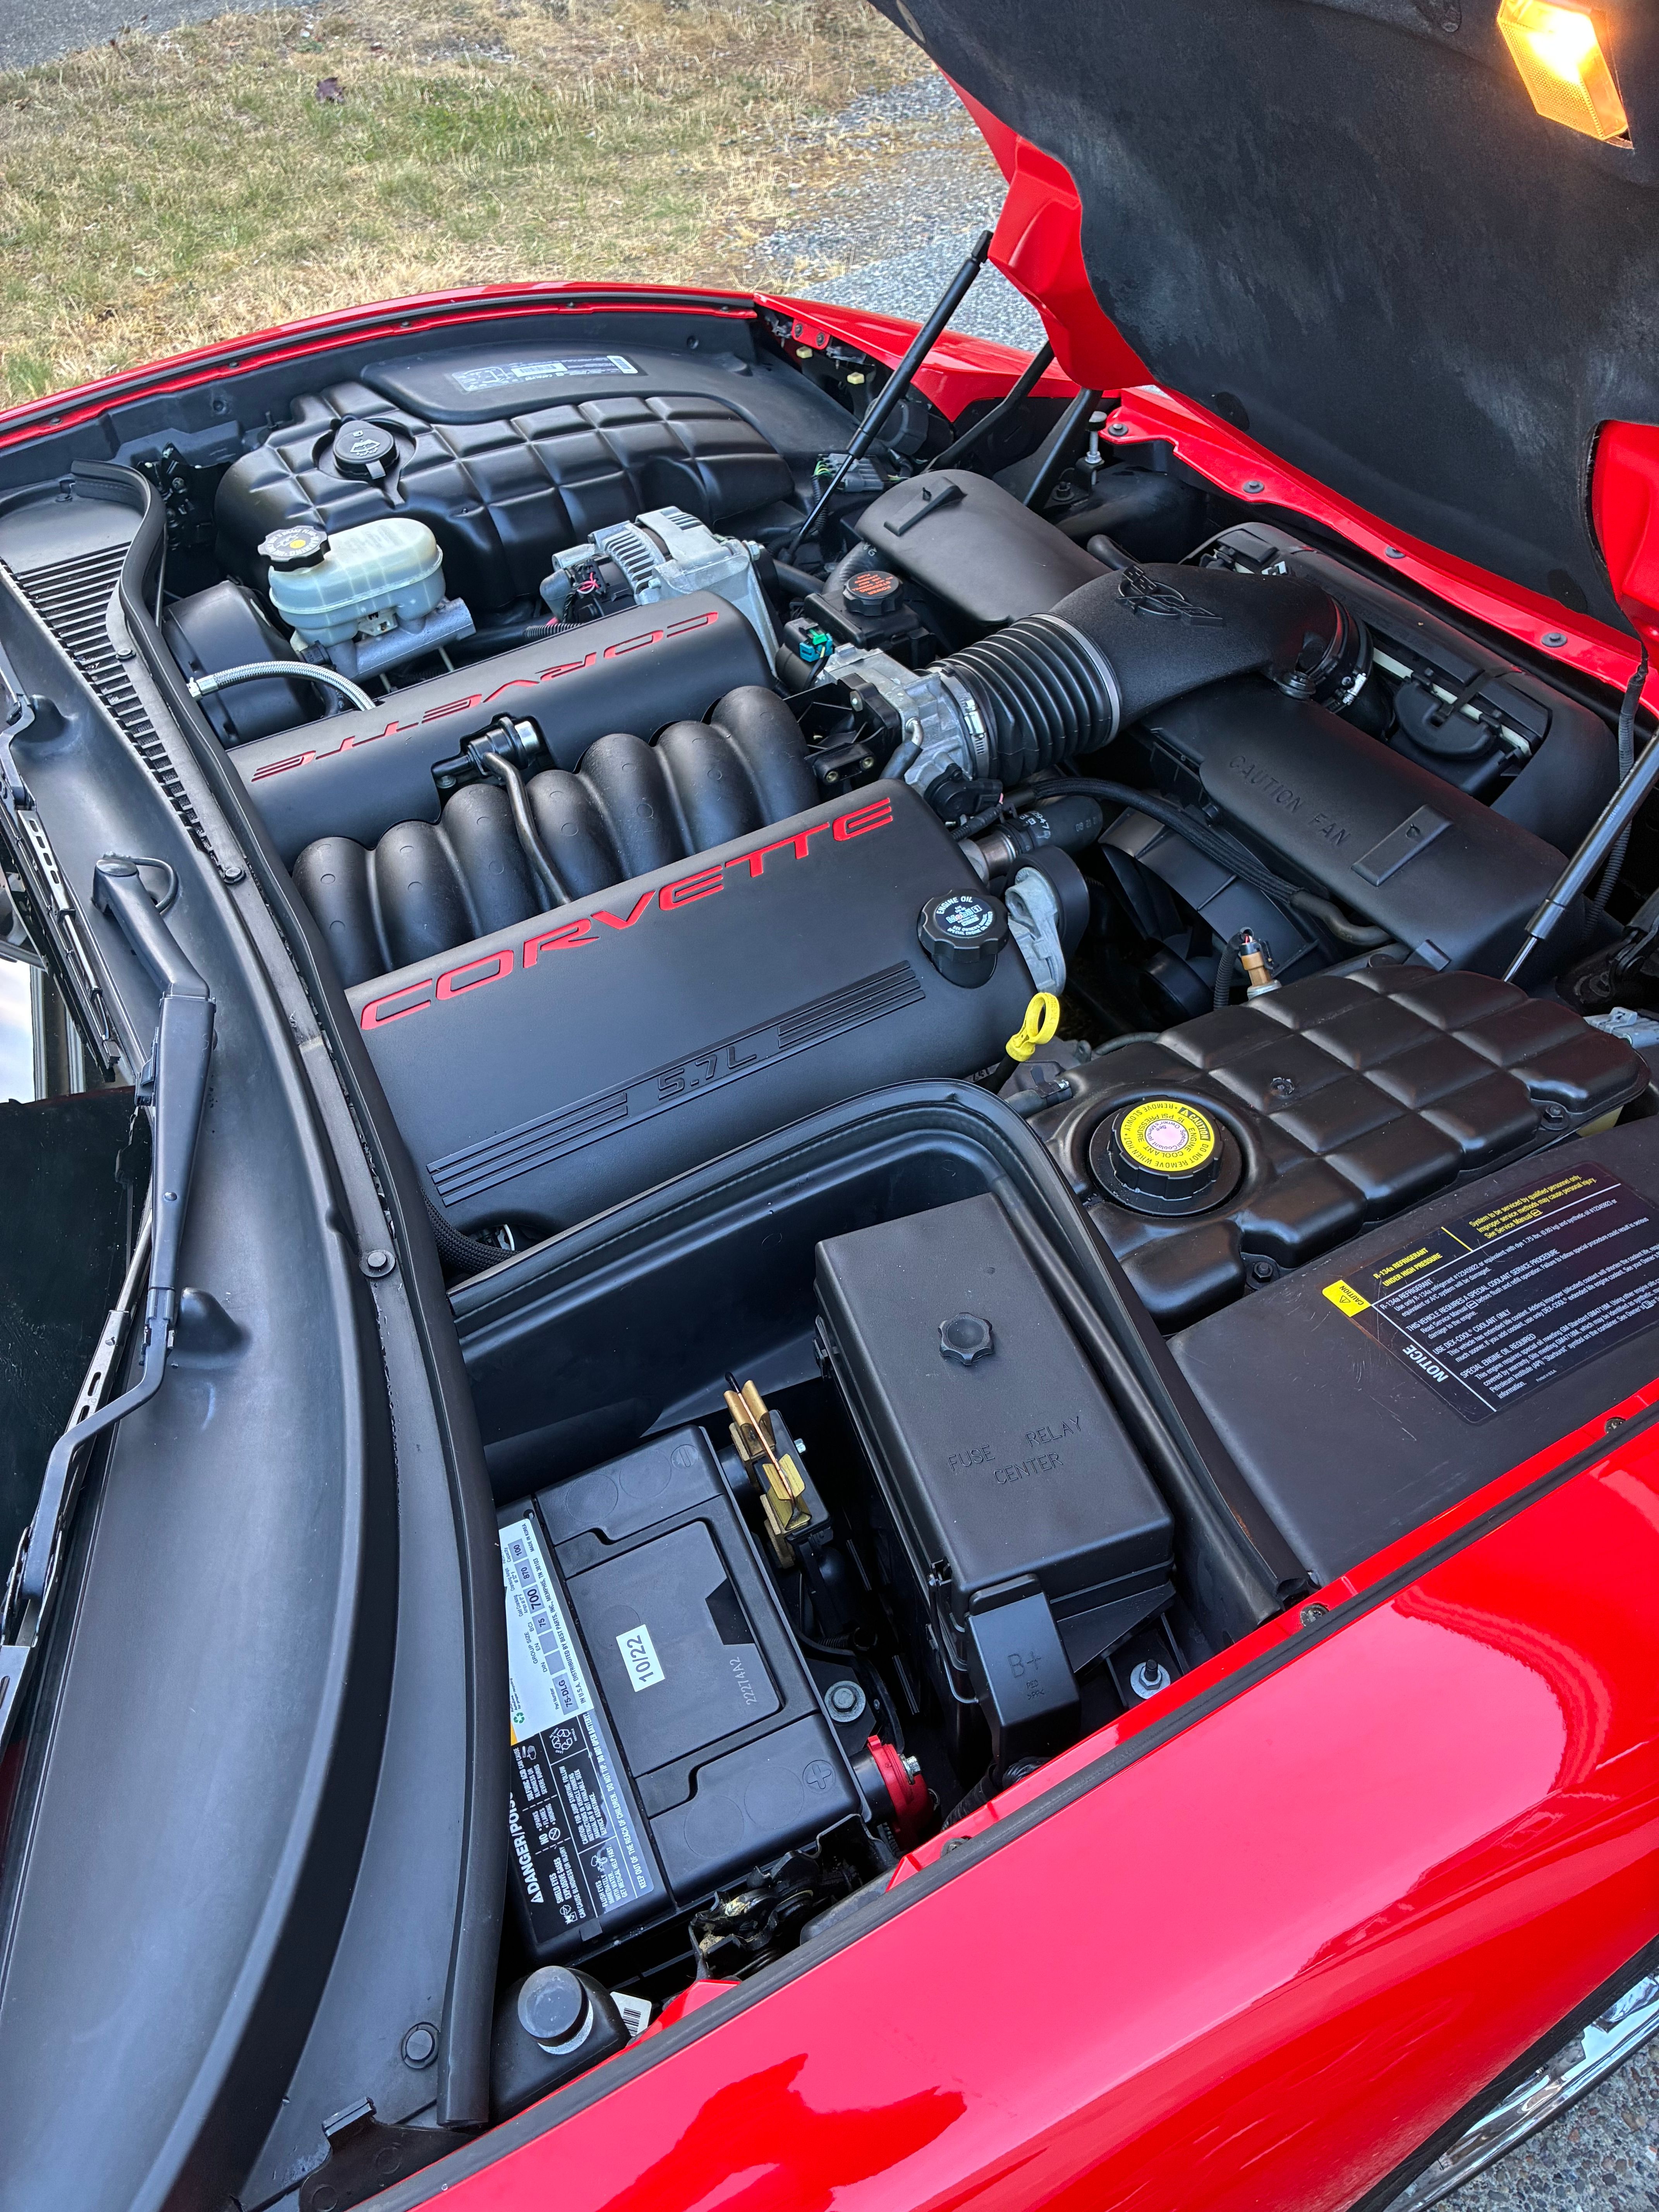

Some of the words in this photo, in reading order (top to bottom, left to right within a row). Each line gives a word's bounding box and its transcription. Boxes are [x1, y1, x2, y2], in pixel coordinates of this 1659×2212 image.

[251, 611, 718, 782] CORVETTE
[1229, 756, 1305, 813] CAUTION
[1309, 812, 1351, 846] FAN
[361, 797, 893, 1030] CORVETTE
[936, 897, 959, 914] ENGINE
[946, 908, 974, 924] Mobil
[658, 1046, 757, 1100] 5.7L
[1144, 1103, 1173, 1112] REMOVE
[1125, 1110, 1142, 1131] SLOWLY
[1137, 1114, 1159, 1142] PRESSURE
[1189, 1114, 1209, 1139] CAUTION
[1147, 1124, 1156, 1141] Manual
[1177, 1129, 1186, 1147] Special
[1184, 1128, 1197, 1152] ENGINE
[1124, 1137, 1135, 1149] HOT
[1143, 1145, 1183, 1158] COOLANT
[1153, 1142, 1177, 1150] Coolant
[1200, 1144, 1209, 1152] DO
[1132, 1149, 1152, 1165] WHEN
[1190, 1152, 1203, 1164] NOT
[1484, 1230, 1497, 1238] See
[1494, 1222, 1515, 1233] Service
[1512, 1213, 1533, 1225] Manual
[1372, 1266, 1395, 1279] R-134a
[1391, 1247, 1429, 1269] REFRIGERANT
[1382, 1274, 1403, 1286] UNDER
[1400, 1266, 1417, 1277] HIGH
[1413, 1252, 1443, 1269] PRESSURE
[1339, 1285, 1364, 1306] CAUTION
[1379, 1297, 1401, 1310] R-134a
[1397, 1278, 1434, 1299] REFRIGERANT
[1405, 1322, 1421, 1332] THIS
[1417, 1310, 1441, 1325] VEHICLE
[1438, 1297, 1466, 1314] REQUIRES
[1466, 1285, 1491, 1298] SPECIAL
[1487, 1272, 1512, 1287] COOLANT
[1509, 1262, 1532, 1276] SERVICE
[1528, 1249, 1560, 1266] PROCEDURE
[1432, 1345, 1447, 1354] USE
[1471, 1316, 1499, 1333] COOLANT
[1495, 1308, 1512, 1319] ONLY
[1402, 1344, 1449, 1382] NOTICE
[1459, 1363, 1485, 1378] SPECIAL
[1480, 1352, 1503, 1366] ENGINE
[1499, 1347, 1513, 1355] OIL
[1508, 1333, 1537, 1350] REQUIRED
[947, 1444, 995, 1471] FUSE
[1025, 1416, 1081, 1448] RELAY
[993, 1452, 1064, 1484] CENTER
[513, 1544, 522, 1556] 100
[520, 1566, 530, 1579] 870
[532, 1558, 541, 1572] 38103
[540, 1578, 552, 1602] MEMPHIS,
[527, 1588, 541, 1610] 700
[538, 1618, 546, 1627] 75
[551, 1613, 561, 1630] PARTS,
[557, 1630, 565, 1642] BEST
[528, 1644, 538, 1664] GROUP
[534, 1642, 540, 1651] EN
[564, 1650, 578, 1681] DISTRIBUTED
[627, 1635, 654, 1682] 10/22
[1007, 1651, 1042, 1678] B+
[730, 1656, 757, 1705] 22274A2
[558, 1679, 572, 1707] 75-DLG
[575, 1682, 584, 1697] U.S.A.
[582, 1711, 596, 1735] BATTERY!
[589, 1732, 600, 1747] OPEN
[513, 1747, 522, 1761] CAUSE
[593, 1744, 603, 1756] NOT
[596, 1753, 605, 1763] DO
[519, 1768, 528, 1780] ACID
[533, 1764, 543, 1779] BURNS
[599, 1762, 609, 1774] TIP.
[529, 1774, 541, 1798] BLINDNESS
[538, 1778, 548, 1795] SEVERE
[602, 1772, 612, 1784] NOT
[522, 1779, 534, 1801] SULFURIC
[606, 1783, 615, 1792] DO
[545, 1803, 556, 1822] SMOKING
[609, 1791, 623, 1819] CHILDREN.
[532, 1810, 542, 1828] SPARKS
[539, 1807, 549, 1825] FLAMES
[618, 1817, 626, 1827] OF
[538, 1833, 549, 1845] NO
[620, 1825, 632, 1844] REACH
[559, 1846, 569, 1863] INJURY
[605, 1844, 615, 1858] FAST.
[626, 1843, 635, 1855] THE
[553, 1857, 564, 1874] GASES
[610, 1857, 618, 1869] HELP
[630, 1855, 638, 1863] OF
[632, 1863, 642, 1875] OUT
[548, 1872, 559, 1886] EYES
[558, 1872, 572, 1899] EXPLOSIVE
[565, 1869, 579, 1894] BLINDNESS
[595, 1880, 604, 1893] EYES
[606, 1870, 618, 1889] WATER.
[613, 1868, 625, 1889] MEDICAL
[636, 1874, 647, 1890] KEEP
[552, 1885, 564, 1904] SHIELD
[601, 1873, 616, 1904] IMMEDIATELY
[613, 1887, 621, 1901] WITH
[620, 1888, 628, 1898] GET
[573, 1893, 583, 1909] CAUSE
[598, 1891, 609, 1907] FLUSH
[577, 1907, 586, 1918] CAN
